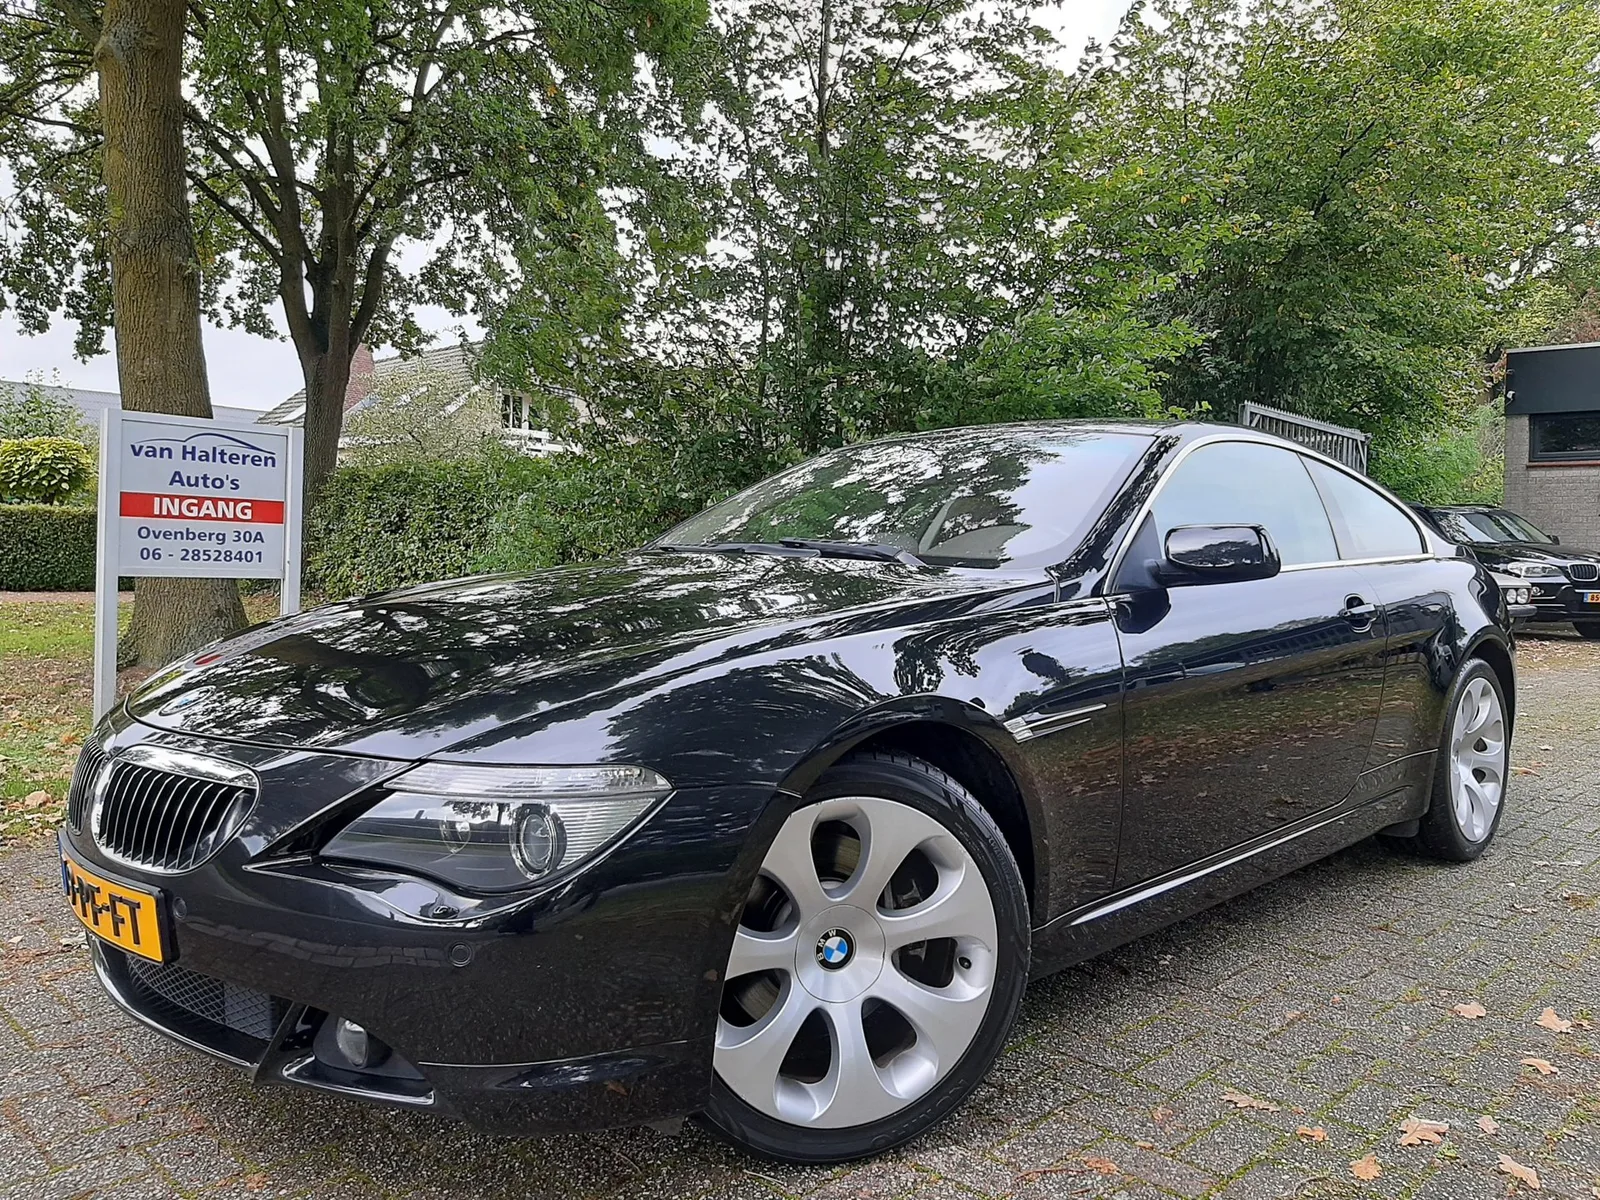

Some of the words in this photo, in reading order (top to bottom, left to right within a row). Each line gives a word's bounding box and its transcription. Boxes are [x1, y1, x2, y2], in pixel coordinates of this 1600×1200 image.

[130, 444, 172, 460] van
[182, 444, 276, 468] Halteren
[168, 470, 240, 490] Auto's
[153, 497, 252, 520] INGANG
[137, 526, 226, 545] Ovenberg
[232, 530, 265, 544] 30A
[140, 547, 162, 561] 06
[180, 548, 263, 563] 28528401
[816, 928, 837, 961] BMW
